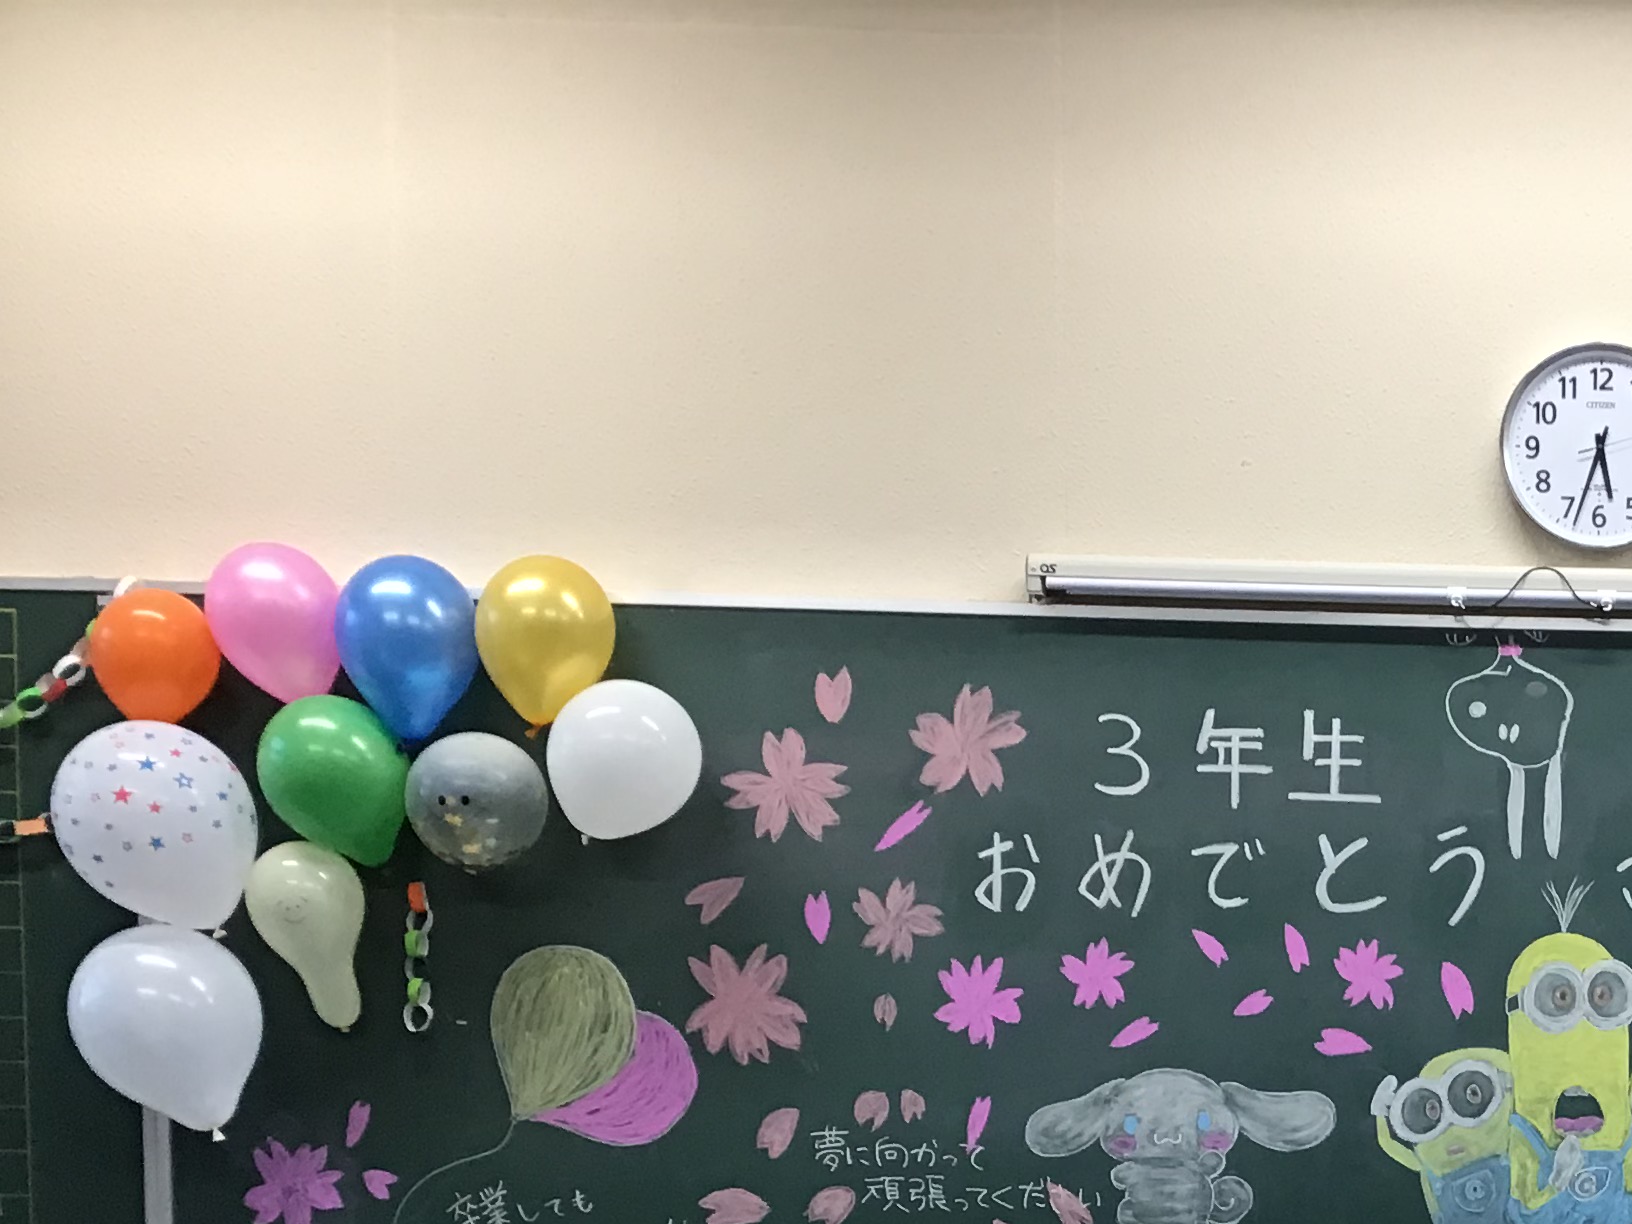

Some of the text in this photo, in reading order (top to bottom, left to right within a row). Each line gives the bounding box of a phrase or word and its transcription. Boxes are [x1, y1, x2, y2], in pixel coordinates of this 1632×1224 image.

[1558, 376, 1577, 400] 11
[1590, 367, 1614, 391] 12
[1532, 401, 1557, 424] 10
[1586, 401, 1616, 409] CITIZEN
[1525, 435, 1540, 459] 9
[1535, 469, 1551, 493] 8
[1561, 496, 1575, 519] 7
[1591, 505, 1607, 528] 6
[1095, 707, 1382, 809] 3年生
[973, 825, 1487, 927] おめでとう
[809, 1125, 985, 1172] 夢に向かって
